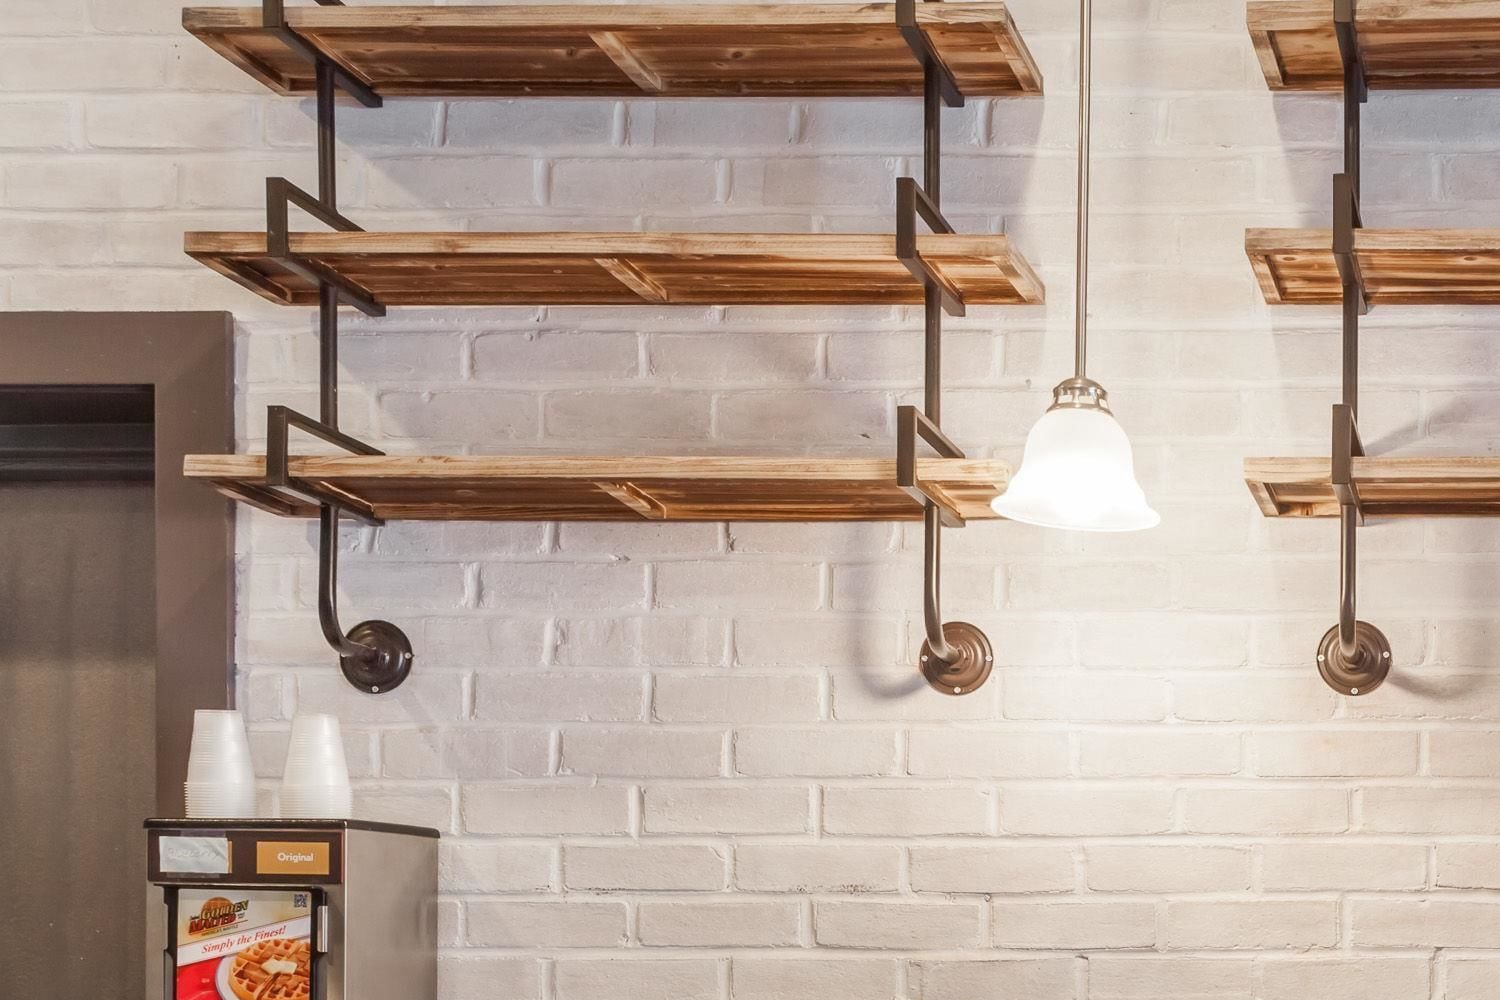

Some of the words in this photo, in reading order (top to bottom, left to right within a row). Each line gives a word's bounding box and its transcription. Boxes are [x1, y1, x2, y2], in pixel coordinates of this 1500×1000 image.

[277, 853, 314, 863] Original
[201, 938, 235, 953] Simply
[236, 934, 252, 945] the
[254, 925, 287, 941] Finest!
